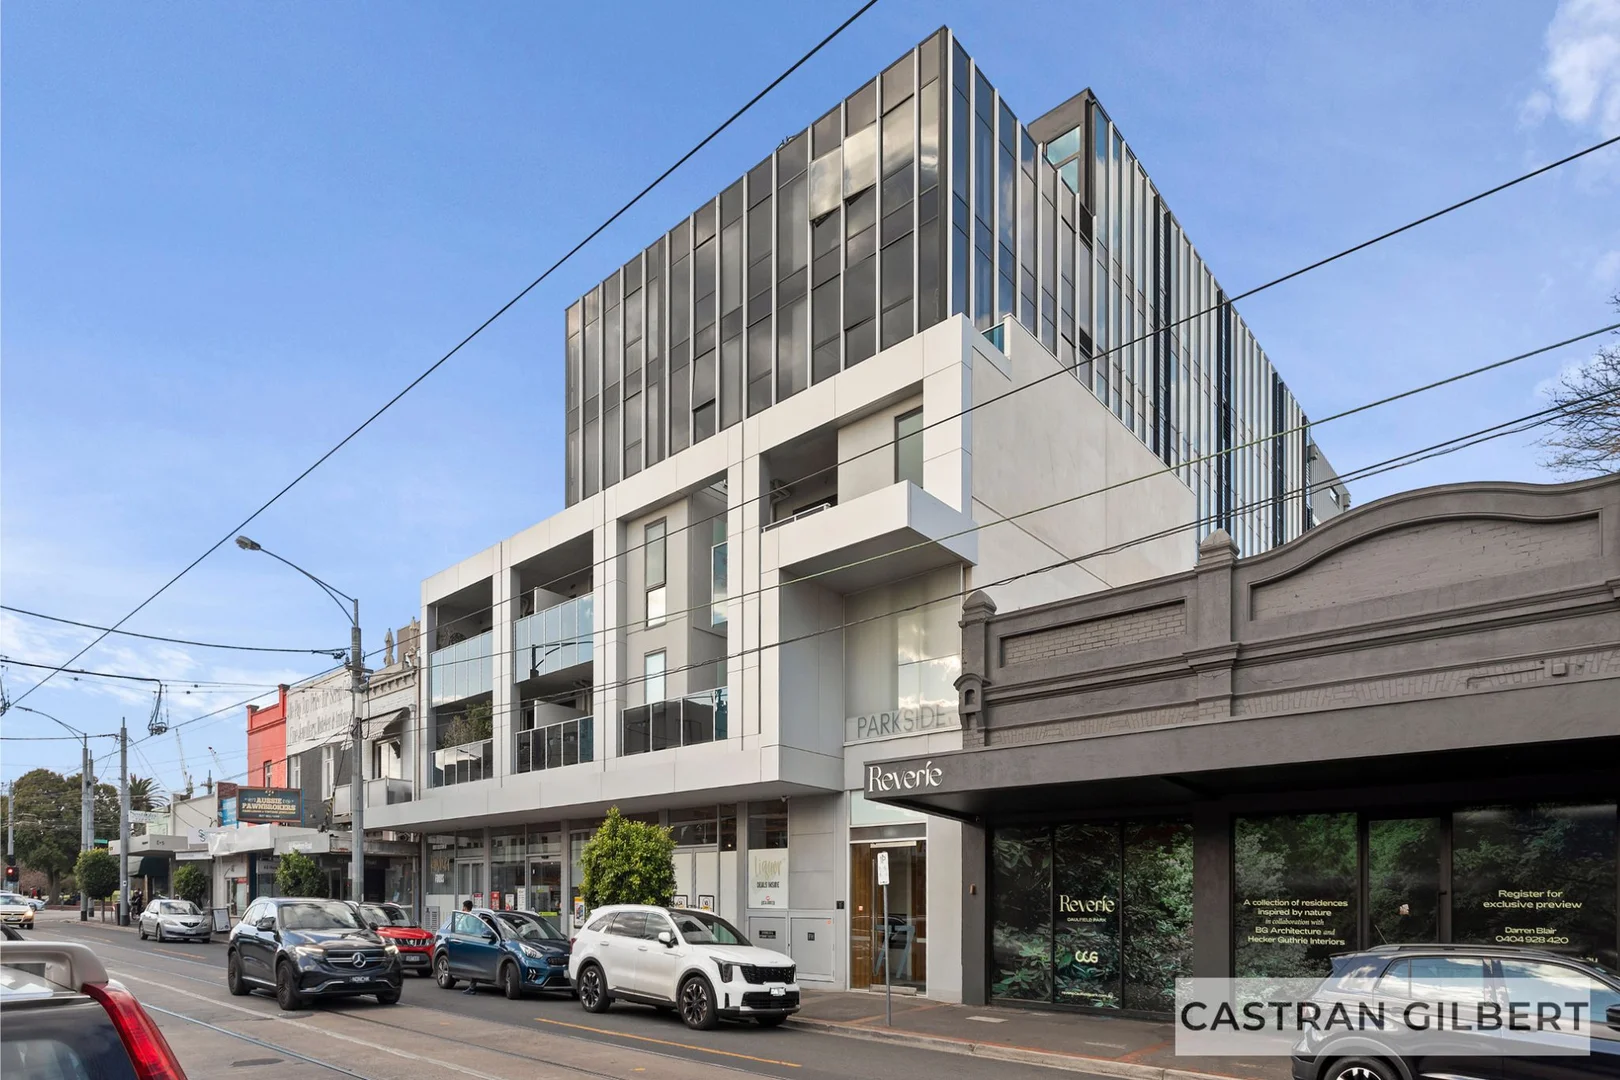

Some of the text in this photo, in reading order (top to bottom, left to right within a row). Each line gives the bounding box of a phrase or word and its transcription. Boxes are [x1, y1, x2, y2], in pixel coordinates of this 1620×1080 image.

[857, 704, 946, 738] PARKSIDE
[754, 856, 783, 880] Liquor
[1498, 889, 1564, 899] Register for
[1301, 899, 1348, 907] residences
[1483, 900, 1582, 910] exclusive preview
[1291, 909, 1303, 917] by
[1270, 926, 1321, 935] Architecture
[1504, 926, 1535, 934] Darren
[1247, 935, 1345, 945] Hecker Guthrie Interiors
[1495, 935, 1569, 944] 0404 928 420
